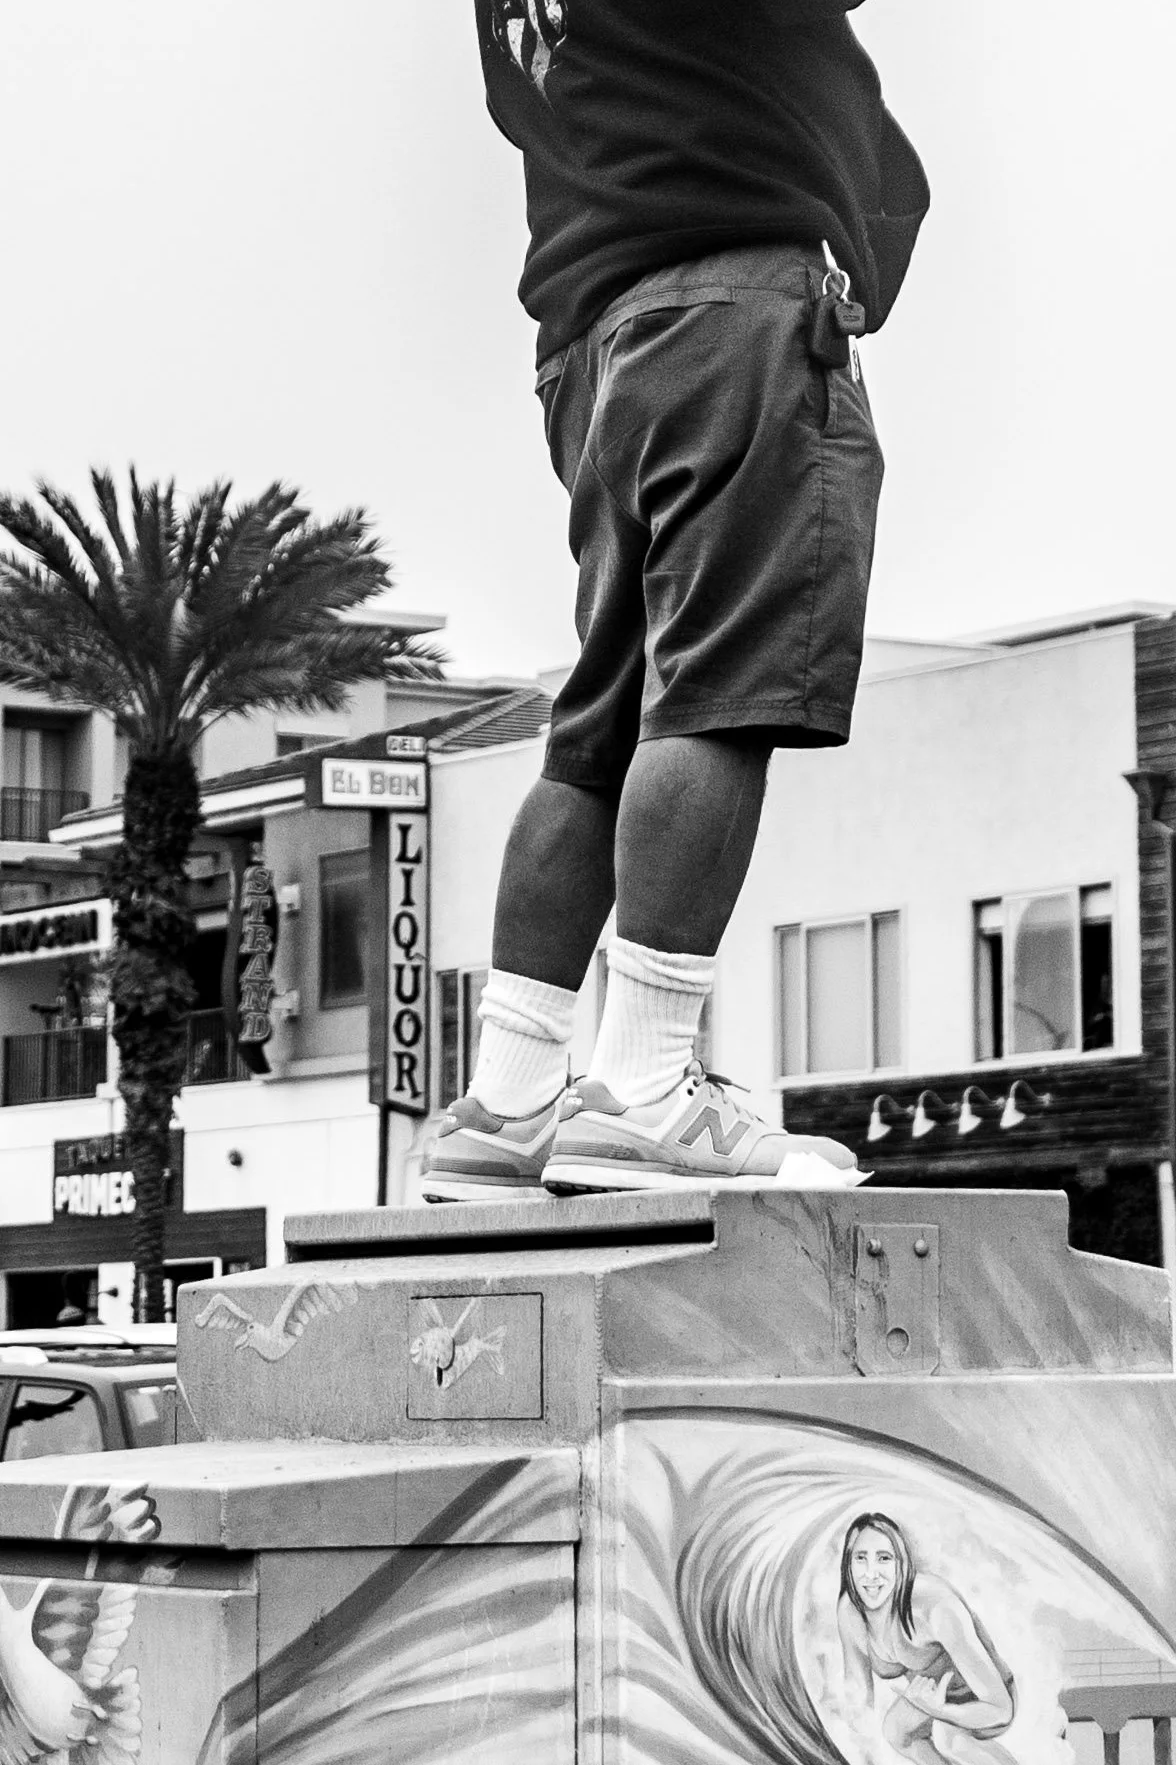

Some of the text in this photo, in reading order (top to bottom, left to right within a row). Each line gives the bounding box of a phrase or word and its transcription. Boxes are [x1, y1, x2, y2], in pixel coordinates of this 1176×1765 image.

[331, 769, 361, 794] EL
[239, 865, 275, 1042] STRAND
[393, 822, 424, 1099] LIQUOR
